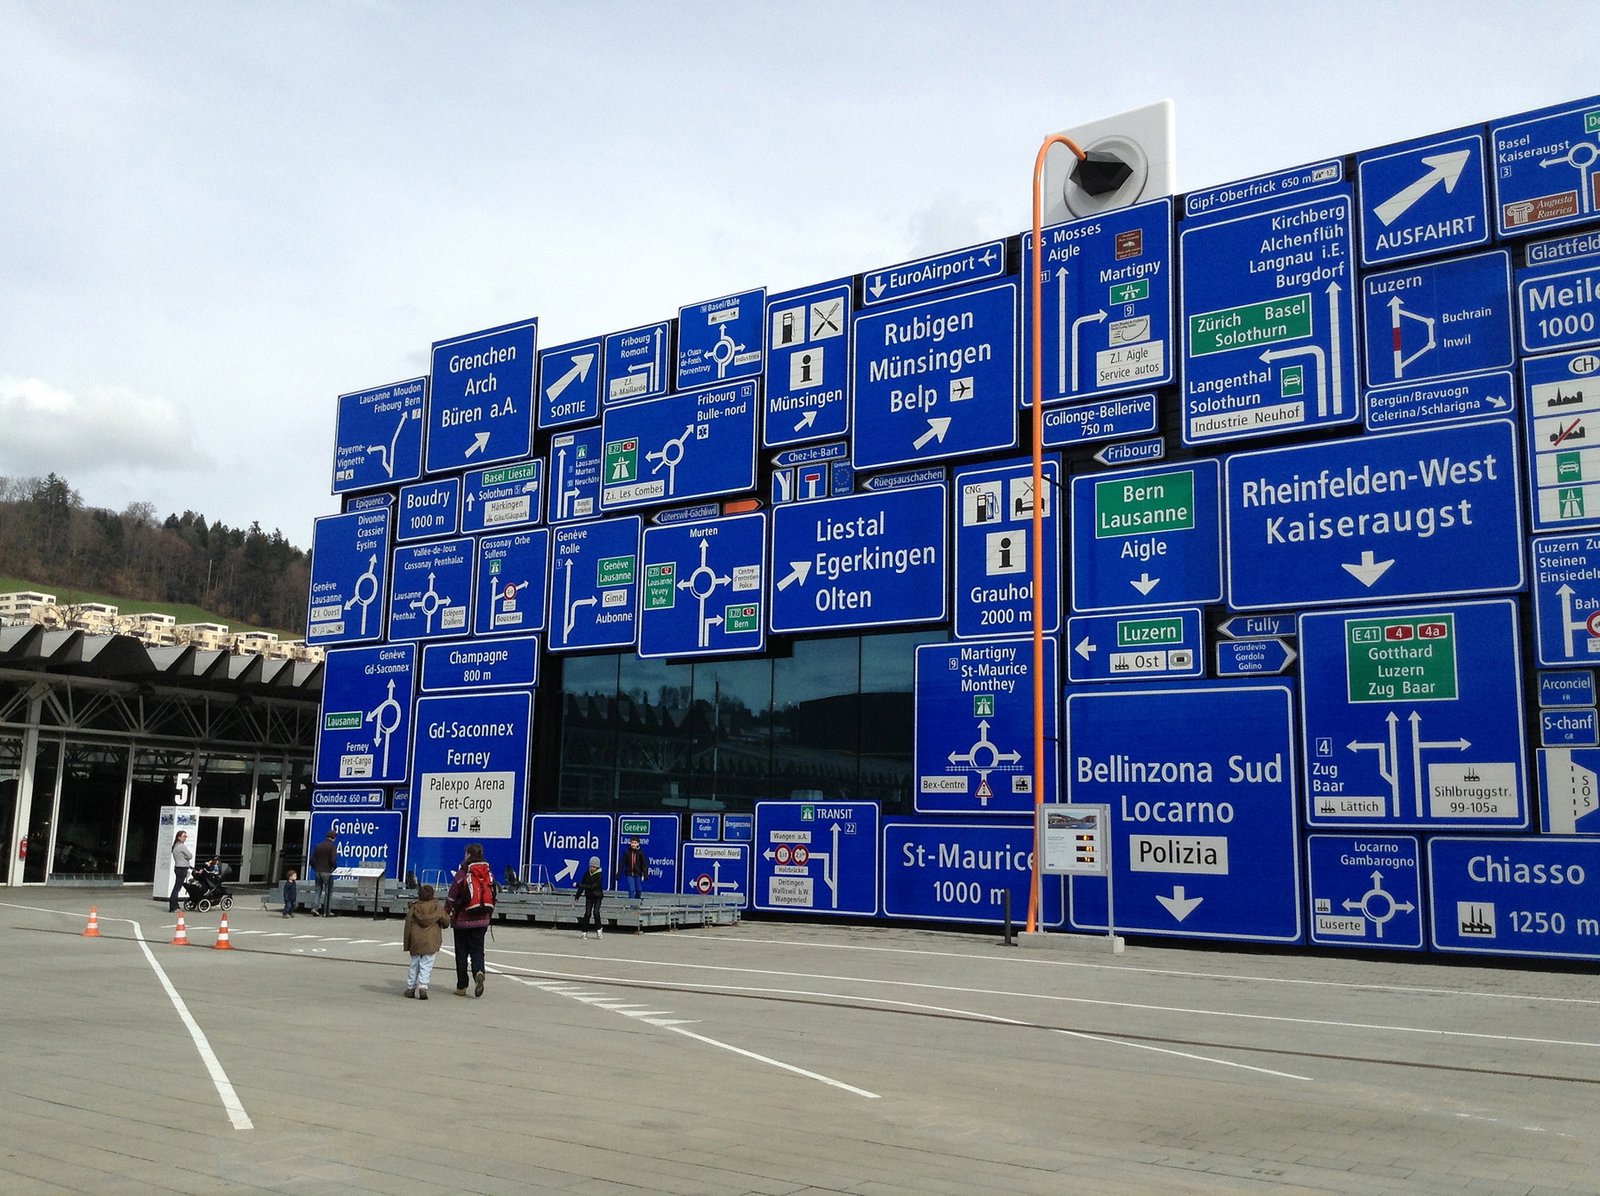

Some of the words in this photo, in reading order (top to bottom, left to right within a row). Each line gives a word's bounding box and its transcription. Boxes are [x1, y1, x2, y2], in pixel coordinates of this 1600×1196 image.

[1498, 134, 1530, 151] Basel
[1499, 140, 1571, 164] Kaiseraugst
[1503, 168, 1509, 177] 3
[1189, 180, 1276, 211] Gipf-Oberfrick
[1281, 176, 1300, 190] 650
[1302, 174, 1312, 185] m
[1536, 195, 1573, 209] Augusta
[1272, 205, 1345, 231] Kirchberg
[1537, 206, 1573, 219] Raurica
[1053, 223, 1101, 244] Mosses
[1260, 224, 1344, 253] Alchenflüh
[1375, 215, 1476, 251] AUSFAHRT
[1048, 244, 1080, 262] Aigle
[1250, 250, 1313, 274] Langnau
[1322, 243, 1345, 258] i.E.
[890, 256, 975, 289] EuroAirport
[1100, 260, 1161, 283] Martigny
[1276, 262, 1345, 289] Burgdorf
[1369, 274, 1422, 295] Luzern
[1197, 313, 1242, 333] Zürich
[1264, 299, 1306, 321] Basel
[1442, 307, 1492, 324] Buchrain
[884, 311, 974, 346] Rubigen
[1539, 312, 1595, 339] 1000
[621, 335, 651, 347] Fribourg
[1215, 324, 1287, 347] Solothurn
[1443, 334, 1472, 348] Inwil
[449, 346, 516, 373] Grenchen
[621, 346, 649, 359] Romont
[1126, 348, 1149, 364] Aigle
[869, 343, 991, 382] Münsingen
[1572, 357, 1594, 373] CH
[1100, 367, 1130, 382] Service
[1135, 362, 1160, 375] autos
[1189, 367, 1272, 394] Langenthal
[465, 373, 497, 396] Arch
[359, 390, 390, 405] Lausanne
[394, 384, 422, 397] Moudon
[698, 389, 736, 406] Fribourg
[770, 389, 843, 413] Münsingen
[890, 384, 938, 413] Belp
[1190, 392, 1261, 414] Solothurn
[1370, 385, 1469, 408] Bergün/Bravuogn
[374, 401, 402, 414] Fribourg
[405, 397, 421, 408] Bern
[441, 406, 482, 428] Büren
[490, 397, 517, 418] a.A.
[551, 401, 586, 418] SORTIE
[697, 403, 746, 422] Bulle-nord
[1046, 401, 1151, 427] Collonge-Bellerive
[1371, 399, 1481, 423] Celerina/Schlarigna
[1195, 414, 1249, 432] Industrie
[1254, 405, 1301, 423] Neuhof
[1081, 424, 1100, 436] 750
[1103, 423, 1114, 433] m
[788, 447, 838, 462] Chez-le-Bart
[1108, 442, 1161, 461] Fribourg
[337, 456, 365, 469] Vignette
[484, 471, 505, 484] Basel
[508, 466, 534, 479] Liestal
[874, 469, 943, 488] Rüegsauschachen
[1242, 454, 1497, 508] Rheinfelden-West
[478, 488, 513, 501] Solothurn
[620, 490, 631, 498] Les
[635, 485, 663, 496] Combes
[965, 485, 982, 494] CNG
[1123, 484, 1164, 503] Bern
[407, 490, 450, 509] Boudry
[358, 514, 386, 525] Divonne
[410, 515, 433, 529] 1000
[435, 516, 444, 525] m
[816, 511, 885, 542] Liestal
[1101, 507, 1188, 530] Lausanne
[1266, 499, 1473, 544] Kaiseraugst
[357, 526, 384, 538] Crassier
[557, 529, 588, 542] Genève
[689, 527, 718, 538] Murten
[356, 539, 377, 552] Eysins
[482, 540, 512, 550] Cossonay
[514, 535, 531, 545] Orbe
[560, 544, 580, 555] Rolle
[1120, 538, 1167, 561] Aigle
[1538, 542, 1579, 554] Luzern
[404, 560, 433, 571] Cossonay
[603, 560, 629, 571] Genève
[816, 545, 936, 580] Egerkingen
[1540, 556, 1587, 568] Steinen
[600, 571, 632, 583] Lausanne
[311, 594, 342, 605] Lausanne
[394, 591, 422, 601] Lausanne
[604, 593, 626, 605] Gimel
[815, 586, 872, 612] Olten
[596, 611, 633, 624] Aubonne
[733, 620, 749, 628] Bern
[981, 610, 1014, 625] 2000
[1247, 618, 1280, 634] Fully
[1123, 624, 1177, 642] Luzern
[1425, 626, 1440, 637] 4a
[379, 649, 406, 661] Genève
[449, 649, 509, 667] Champagne
[961, 646, 1017, 661] Martigny
[1368, 644, 1433, 660] Gotthard
[364, 663, 410, 675] Gd-Saconnex
[1135, 654, 1159, 669] Ost
[1238, 662, 1263, 670] Golino
[463, 669, 480, 681] 800
[483, 672, 491, 680] m
[961, 663, 1027, 678] St-Maurice
[1377, 665, 1424, 678] Luzern
[961, 678, 1015, 693] Monthey
[1368, 682, 1395, 698] Zug
[1403, 681, 1436, 694] Baar
[1543, 677, 1591, 690] Arconciel
[327, 716, 360, 727] Lausanne
[1544, 715, 1592, 730] S-chanf
[429, 721, 514, 740] Gd-Saconnex
[346, 742, 370, 754] Ferney
[1319, 740, 1329, 754] 4
[342, 756, 372, 768] Fret-Cargo
[447, 749, 491, 770] Ferney
[1077, 754, 1213, 783] Bellinzona
[1229, 753, 1283, 783] Sud
[1312, 763, 1338, 778] Zug
[174, 773, 190, 806] 5
[430, 777, 470, 793] Palexpo
[474, 776, 505, 791] Arena
[923, 779, 965, 790] Bex-Centre
[1313, 779, 1345, 792] Baar
[315, 793, 347, 803] Choindez
[1434, 786, 1512, 801] Sihlbruggstr.
[439, 796, 493, 813] Fret-Cargo
[1121, 795, 1234, 824] Locarno
[1340, 801, 1379, 813] Lättich
[1450, 802, 1498, 814] 99-105a
[817, 808, 853, 820] TRANSIT
[331, 818, 379, 835] Genève-
[624, 822, 648, 833] Genève
[543, 831, 599, 850] Viamala
[1354, 841, 1399, 853] Locarno
[336, 841, 389, 862] Aéroport
[1140, 840, 1218, 865] Polizia
[1340, 855, 1415, 869] Gambarogno
[1467, 855, 1586, 885] Chiasso
[934, 881, 982, 905] 1000
[1319, 919, 1361, 932] Luserte
[1509, 911, 1566, 934] 1250
